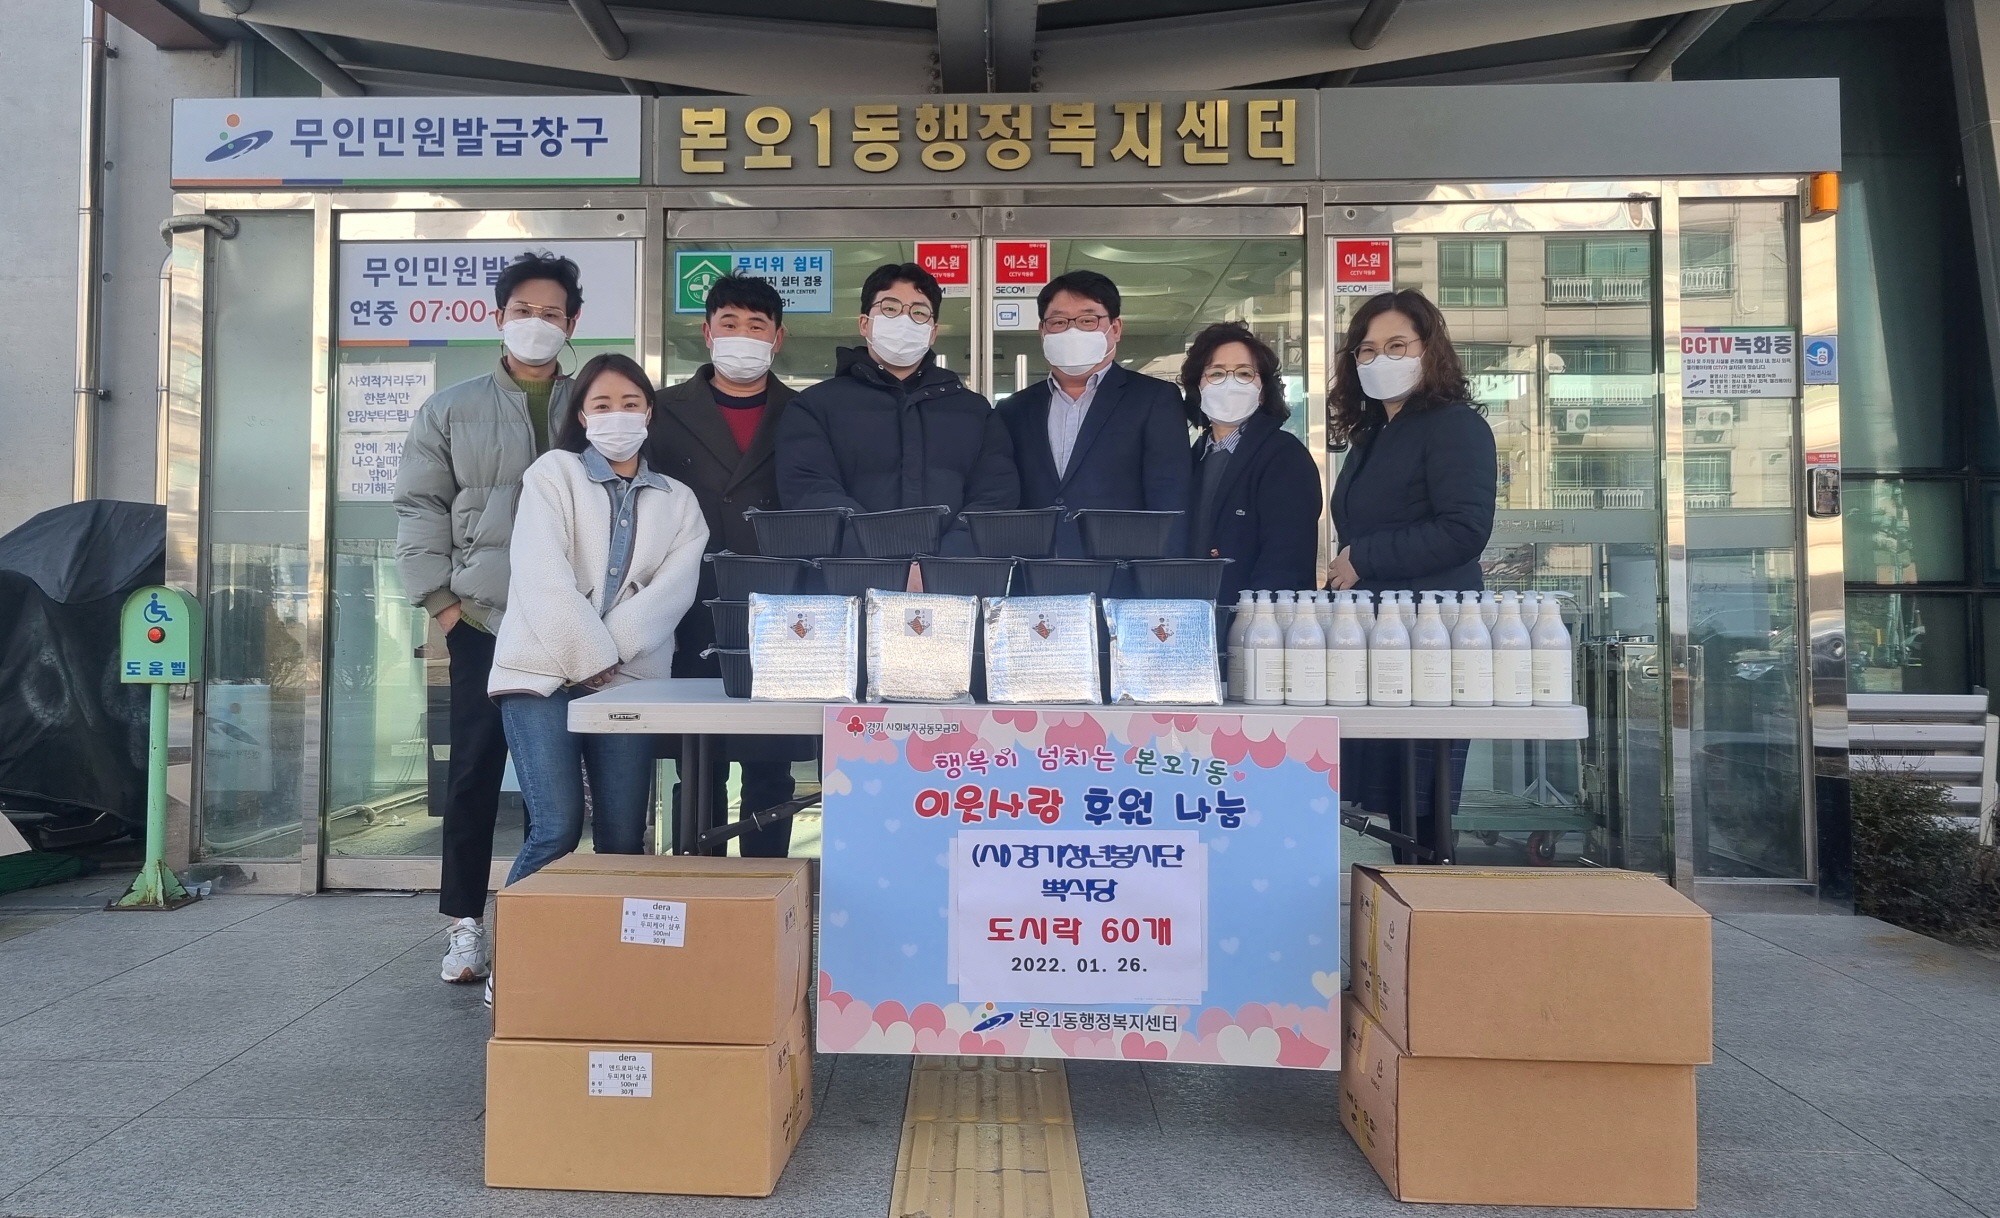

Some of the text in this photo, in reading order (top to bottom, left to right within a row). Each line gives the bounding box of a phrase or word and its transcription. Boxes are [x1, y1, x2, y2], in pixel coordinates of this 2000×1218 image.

[290, 116, 609, 158] 무인민원발급창구
[680, 99, 1296, 174] 본오1동행정복지센터
[738, 256, 823, 272] 무더위 쉼터
[924, 255, 960, 270] 에스원
[1003, 255, 1039, 269] 에스원
[1344, 253, 1381, 268] 에스원
[363, 256, 509, 287] 무인민원발
[781, 276, 799, 287] 쉼터
[804, 275, 823, 287] 겸용
[996, 286, 1025, 294] SECOM
[1337, 285, 1367, 293] SECOM
[350, 300, 503, 326] 연중 07:00~
[348, 375, 427, 388] 사회적거리두기
[364, 392, 410, 405] 한분씩만
[347, 410, 420, 423] 입장부탁드립니
[354, 442, 378, 455] 안에
[352, 455, 401, 468] 나오실때
[352, 482, 396, 494] 대기해주
[866, 722, 959, 735] 경기 사회복지공동모금회
[934, 746, 1229, 785] 행복이 넘치는 본오1동
[914, 785, 1246, 829] 이웃사랑 후원 나눔
[652, 902, 671, 911] dera
[987, 917, 1172, 946] 도시락 60개
[652, 937, 666, 945] 30개
[1011, 957, 1147, 973] 2022. 01. 26.
[1018, 1011, 1177, 1032] 본오1동행정복지센터
[618, 1053, 637, 1062] dera
